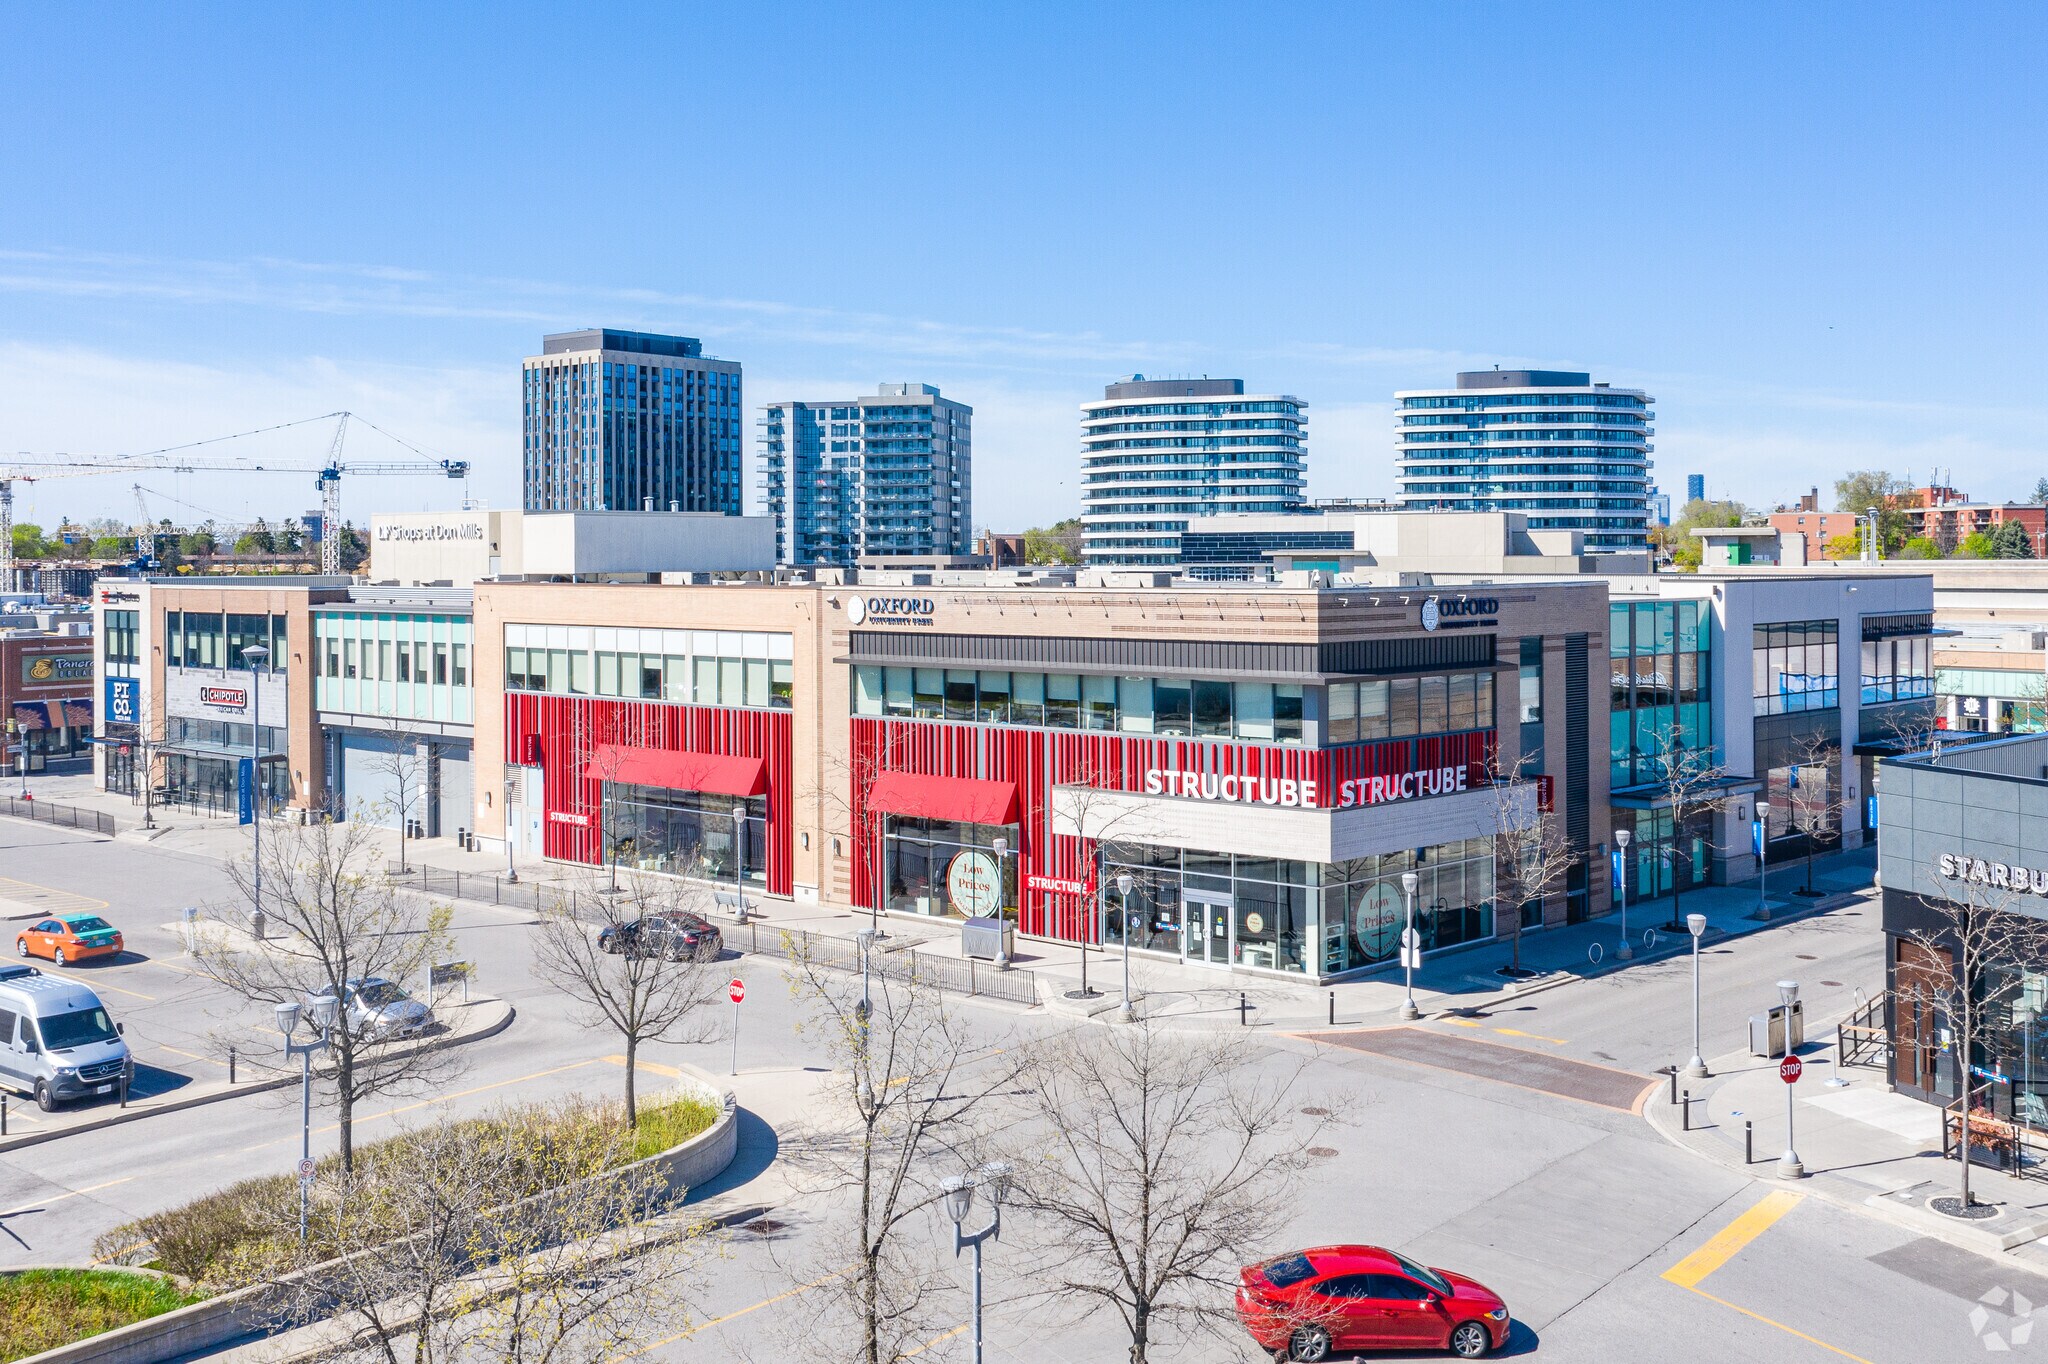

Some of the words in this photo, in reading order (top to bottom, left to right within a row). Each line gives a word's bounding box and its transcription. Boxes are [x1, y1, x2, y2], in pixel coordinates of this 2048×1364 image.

[393, 523, 424, 543] Shops
[424, 525, 436, 541] at
[435, 523, 459, 541] Don
[458, 522, 484, 540] Mills
[868, 597, 935, 614] OXFORD
[1440, 598, 1499, 616] OXFORD
[113, 682, 130, 699] PI
[209, 689, 244, 703] CHIPOTLE
[113, 698, 133, 716] CO.
[1146, 768, 1317, 809] STRUCTUBE
[1340, 764, 1467, 808] STRUCTUBE
[550, 812, 589, 825] STRUCTUBE
[1028, 876, 1088, 895] STRUCTUBE
[1370, 898, 1389, 909] Low
[730, 985, 744, 997] STOP
[1781, 1063, 1801, 1076] STOP
